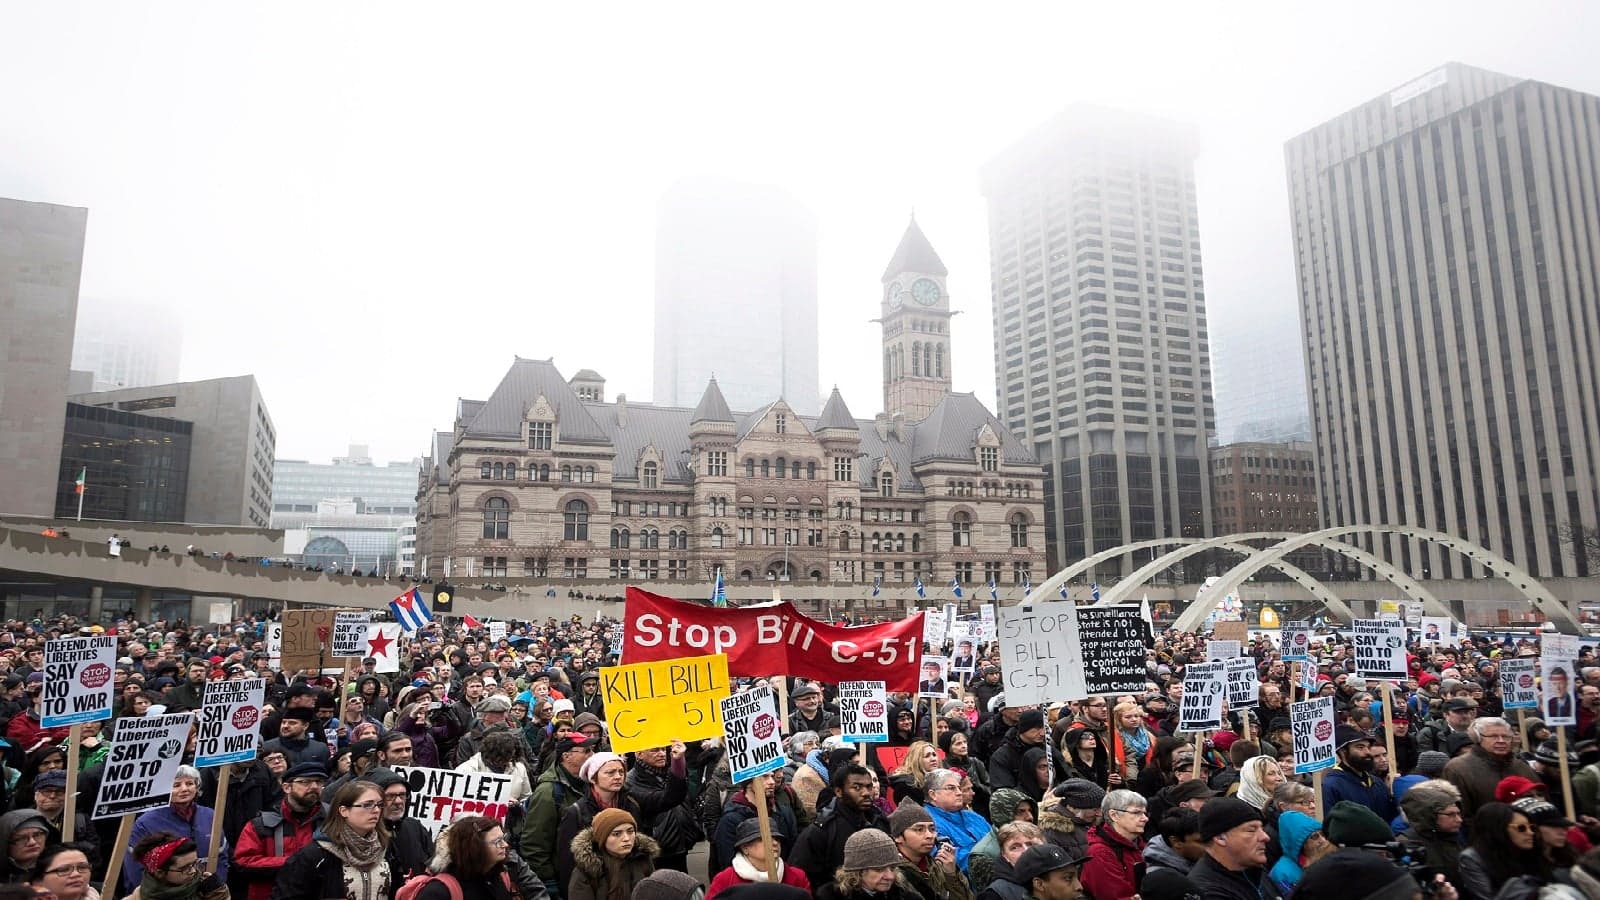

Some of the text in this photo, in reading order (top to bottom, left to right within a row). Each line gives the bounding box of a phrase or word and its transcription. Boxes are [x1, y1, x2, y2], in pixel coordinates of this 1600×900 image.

[1004, 614, 1068, 638] STOP
[1103, 619, 1110, 628] is
[1114, 619, 1132, 628] not
[335, 633, 346, 641] NO
[634, 614, 916, 665] Stop Bill C-51
[1080, 628, 1118, 639] ntended
[1125, 628, 1137, 638] to
[1282, 632, 1294, 640] SAY
[1356, 635, 1377, 646] SAY
[47, 637, 113, 652] DEFEND CIVIL
[1016, 640, 1056, 663] BILL
[46, 649, 98, 663] LIBERTIES
[1101, 648, 1142, 658] intended
[1356, 647, 1392, 658] NO TO
[1092, 656, 1130, 668] control
[1357, 659, 1391, 670] WAR!
[46, 663, 78, 682] SAY
[84, 667, 108, 677] STOP
[1010, 664, 1060, 688] C-51
[1228, 672, 1241, 682] SAY
[1502, 673, 1516, 682] SAY
[45, 681, 69, 698] NO
[206, 680, 263, 693] DEFEND CIVIL
[605, 662, 723, 703] KILL BILL
[1185, 682, 1206, 693] SAY
[1229, 682, 1250, 692] NO TO
[1503, 683, 1515, 692] NO
[43, 698, 66, 716] TO
[73, 692, 107, 712] WAR
[204, 692, 249, 704] LIBERTIES
[721, 686, 770, 711] DEFEND CIVIL
[841, 698, 860, 710] SAY
[1184, 695, 1212, 707] NO TO
[1230, 692, 1250, 702] WAR!
[1504, 692, 1534, 702] TO WAR
[723, 701, 760, 722] LIBERTIES
[1292, 698, 1331, 712] DEFEND CIVIL
[203, 704, 231, 722] SAY
[235, 710, 256, 718] STOP
[614, 699, 715, 738] C- 51
[842, 711, 857, 722] NO
[1183, 708, 1210, 720] WAR!
[1292, 709, 1323, 722] LIBERTIES
[119, 714, 190, 730] Defend Civil
[725, 717, 748, 739] SAY
[754, 716, 772, 730] STOP
[841, 722, 884, 734] TO WAR
[1294, 721, 1312, 737] SAY
[116, 729, 169, 742] Liberties
[201, 722, 222, 739] NO
[199, 734, 254, 756] TO WAR
[728, 736, 747, 755] NO
[1295, 736, 1309, 751] NO
[112, 742, 150, 762] SAY
[730, 752, 748, 771] TO
[752, 742, 779, 765] WAR
[1295, 744, 1333, 764] TO WAR
[106, 760, 162, 782] NO TO
[102, 779, 154, 802] WAR!
[463, 775, 511, 801] LET
[409, 794, 431, 818] HE
